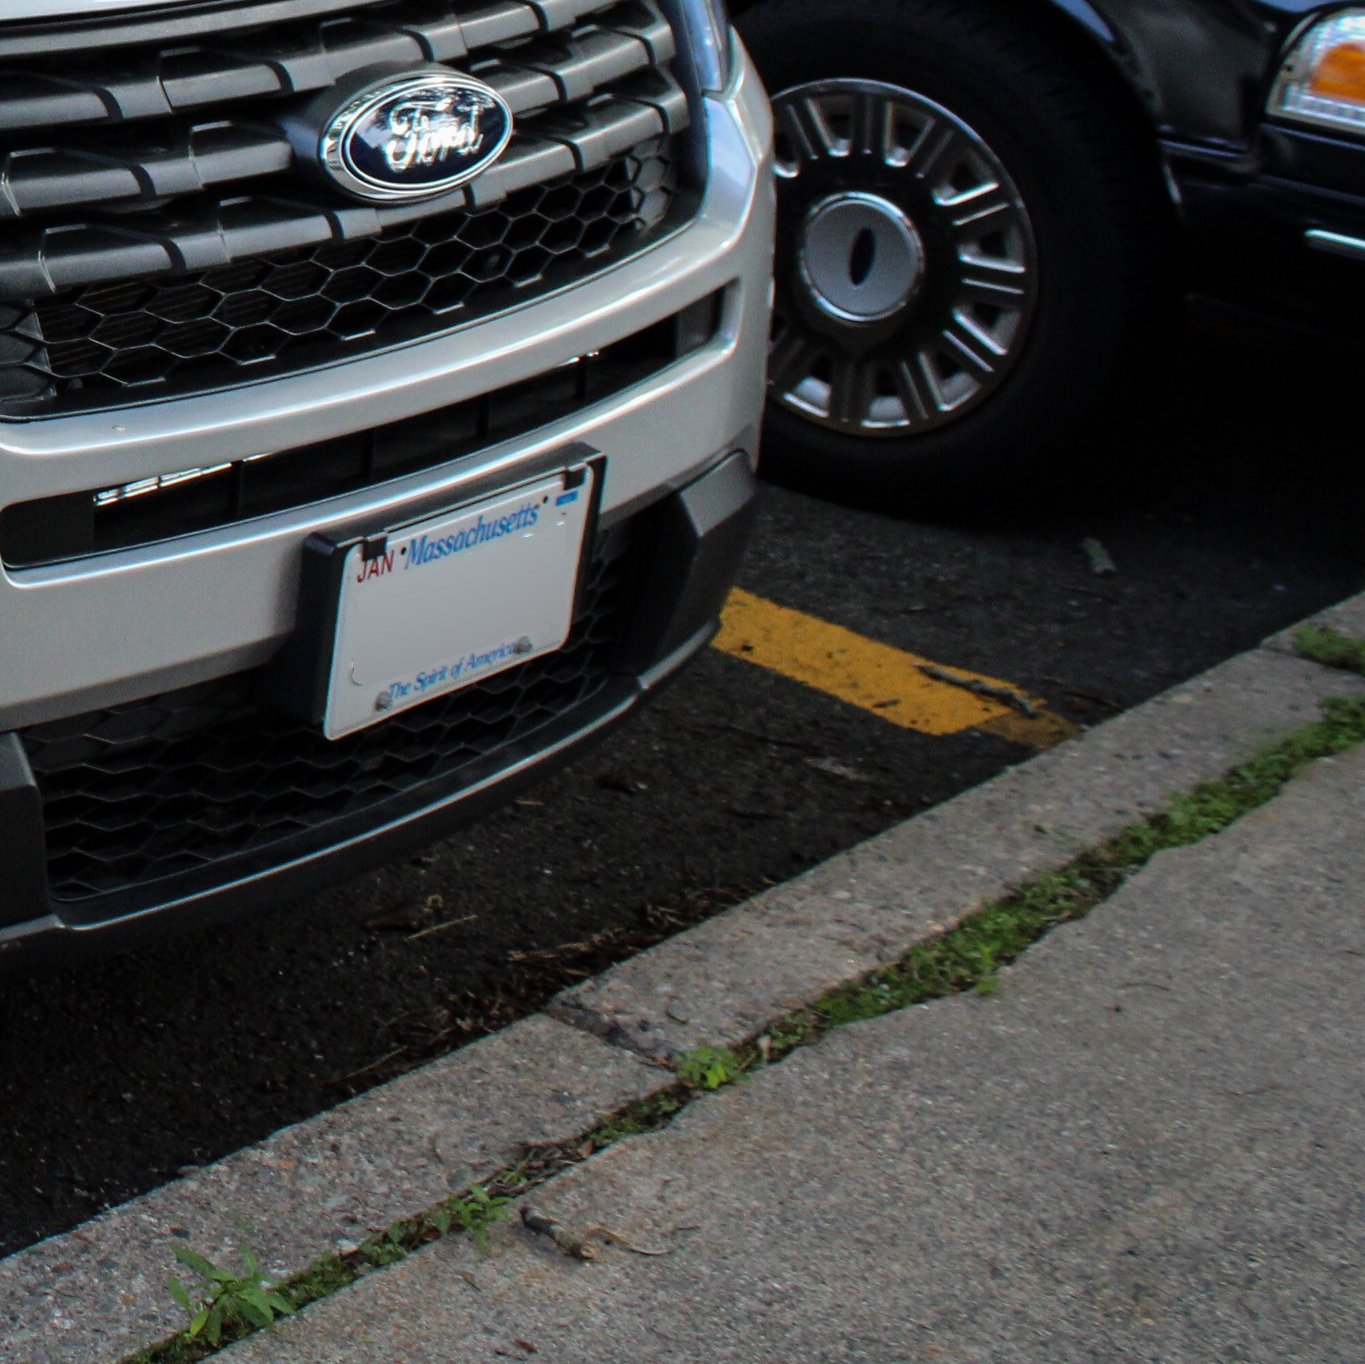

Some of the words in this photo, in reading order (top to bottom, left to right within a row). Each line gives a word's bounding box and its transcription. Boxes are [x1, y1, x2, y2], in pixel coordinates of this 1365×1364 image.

[384, 97, 491, 173] Ford
[357, 550, 394, 583] JAN
[404, 503, 539, 570] Massachusetts
[388, 682, 410, 701] The
[414, 666, 449, 692] Spirit
[450, 655, 466, 679] of
